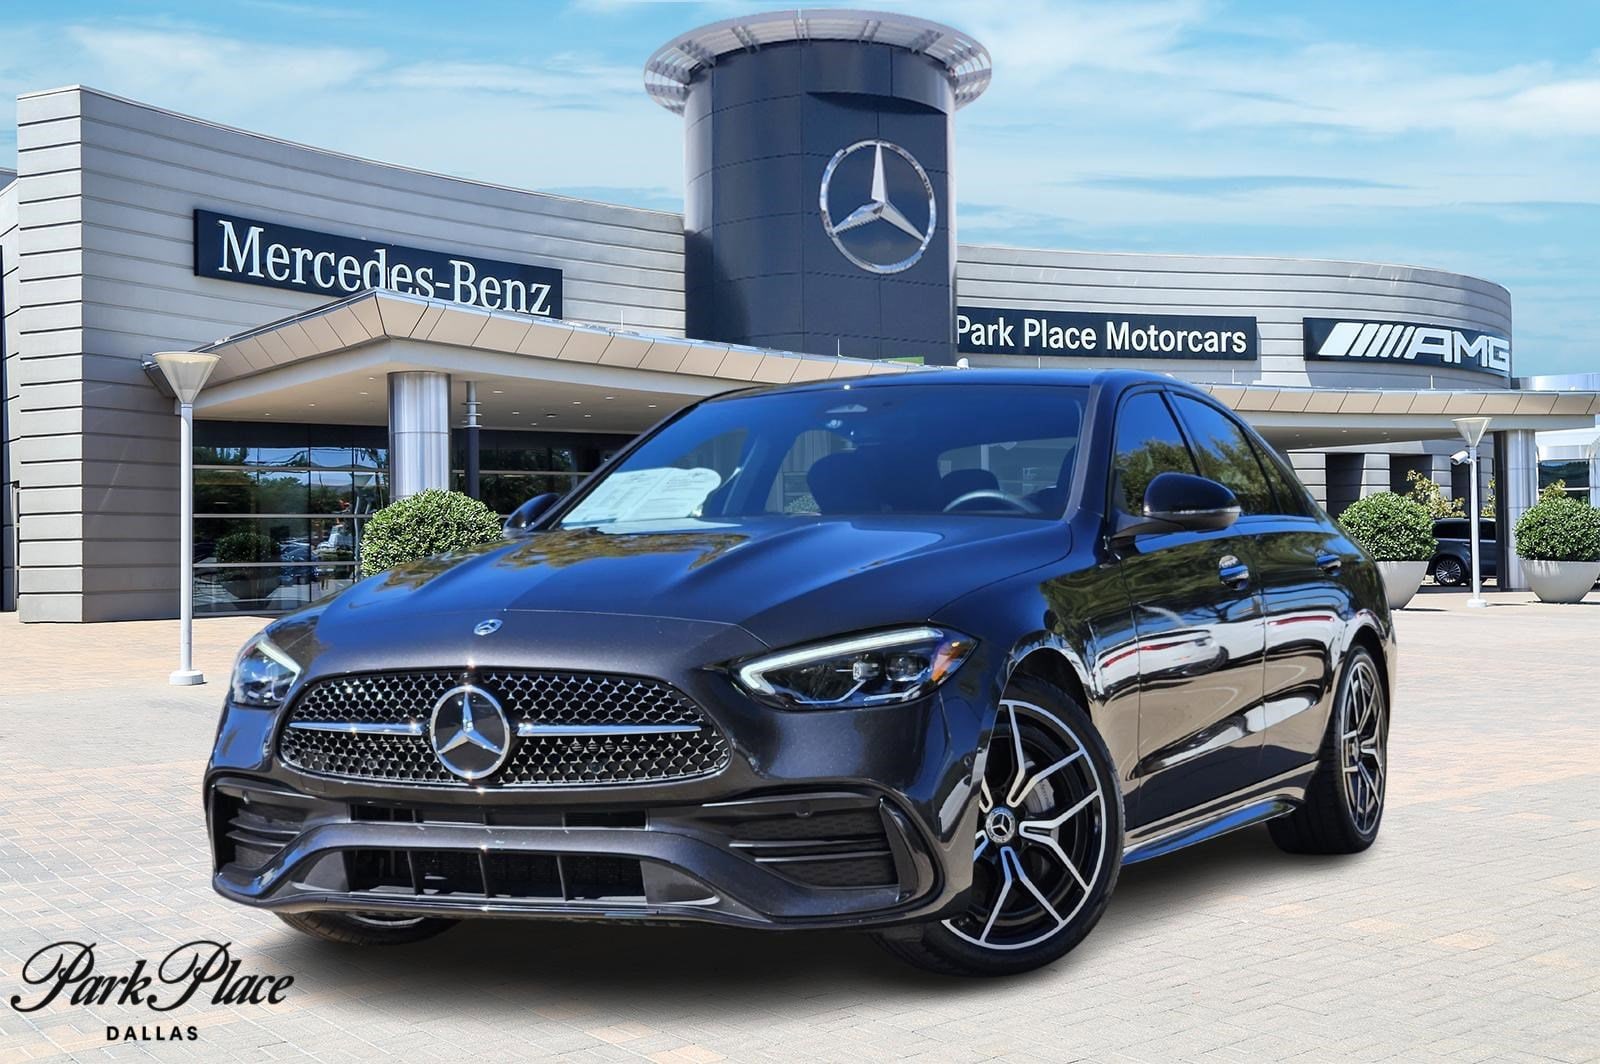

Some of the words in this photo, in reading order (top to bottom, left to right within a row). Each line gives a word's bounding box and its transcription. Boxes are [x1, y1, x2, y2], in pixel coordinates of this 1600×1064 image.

[217, 219, 552, 316] Mercedes-Benz
[957, 315, 1015, 347] Park
[1023, 318, 1097, 350] Place
[1106, 321, 1247, 354] Motorcars
[1404, 327, 1510, 372] AMG
